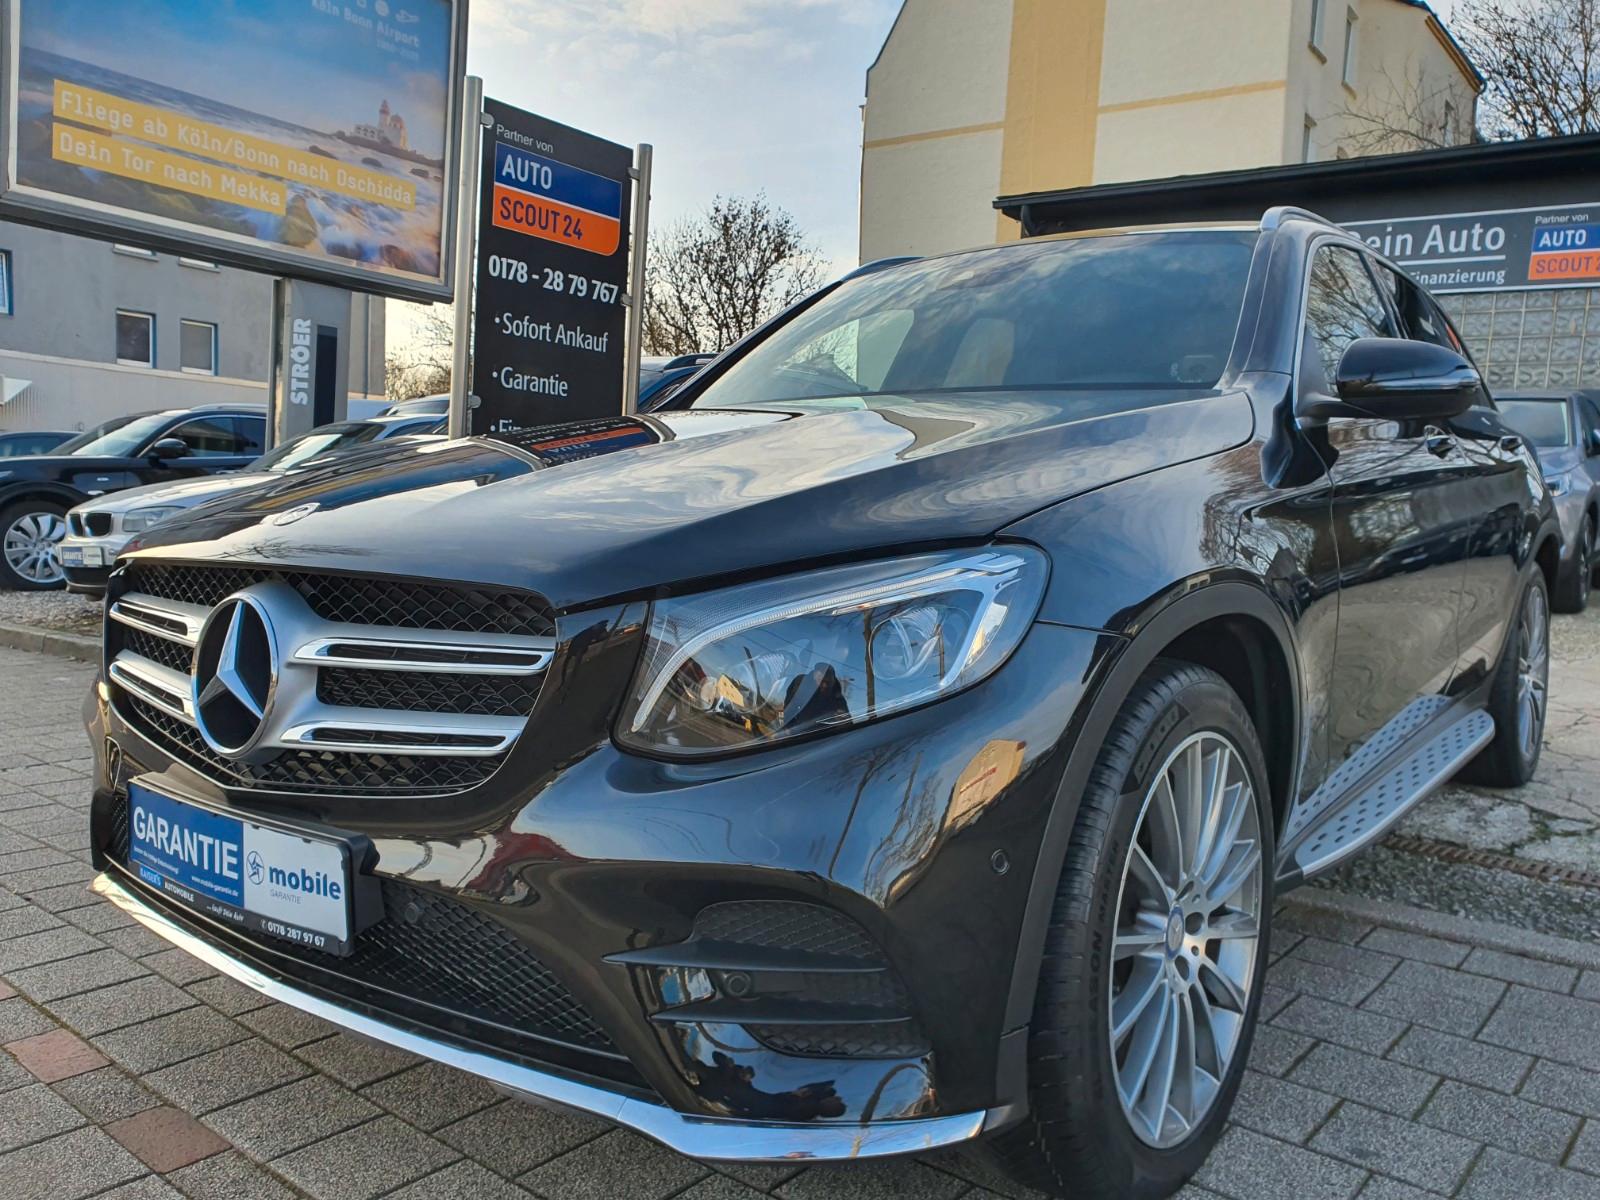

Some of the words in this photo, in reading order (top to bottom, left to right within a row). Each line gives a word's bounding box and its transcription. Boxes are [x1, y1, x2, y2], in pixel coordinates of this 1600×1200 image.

[376, 21, 419, 48] Airport
[61, 90, 134, 129] Fliege
[143, 117, 168, 138] ab
[177, 123, 280, 169] Köln/Bonn
[287, 159, 329, 182] nach
[336, 169, 411, 204] Dschidda
[496, 124, 533, 145] Partner
[535, 138, 554, 153] von
[60, 132, 112, 163] Dein
[122, 148, 155, 172] Tor
[163, 164, 212, 189] nach
[221, 174, 281, 206] Mekka
[502, 154, 552, 190] AUTO
[1535, 215, 1570, 225] Partner
[1571, 213, 1589, 222] von
[1349, 224, 1413, 257] ein
[1421, 222, 1505, 255] Auto
[1538, 228, 1587, 248] AUTO
[488, 254, 528, 283] 0178
[542, 267, 564, 292] 28
[568, 273, 588, 297] 79
[591, 279, 619, 304] 767
[502, 312, 552, 342] Sofort
[554, 323, 609, 353] Ankauf
[290, 318, 311, 405] STRÖER
[500, 366, 569, 397] Garantie
[133, 806, 239, 880] GARANTIE
[269, 864, 341, 900] mobile
[270, 889, 302, 905] GARANTIE
[267, 921, 286, 936] 0178
[314, 935, 326, 948] 67
